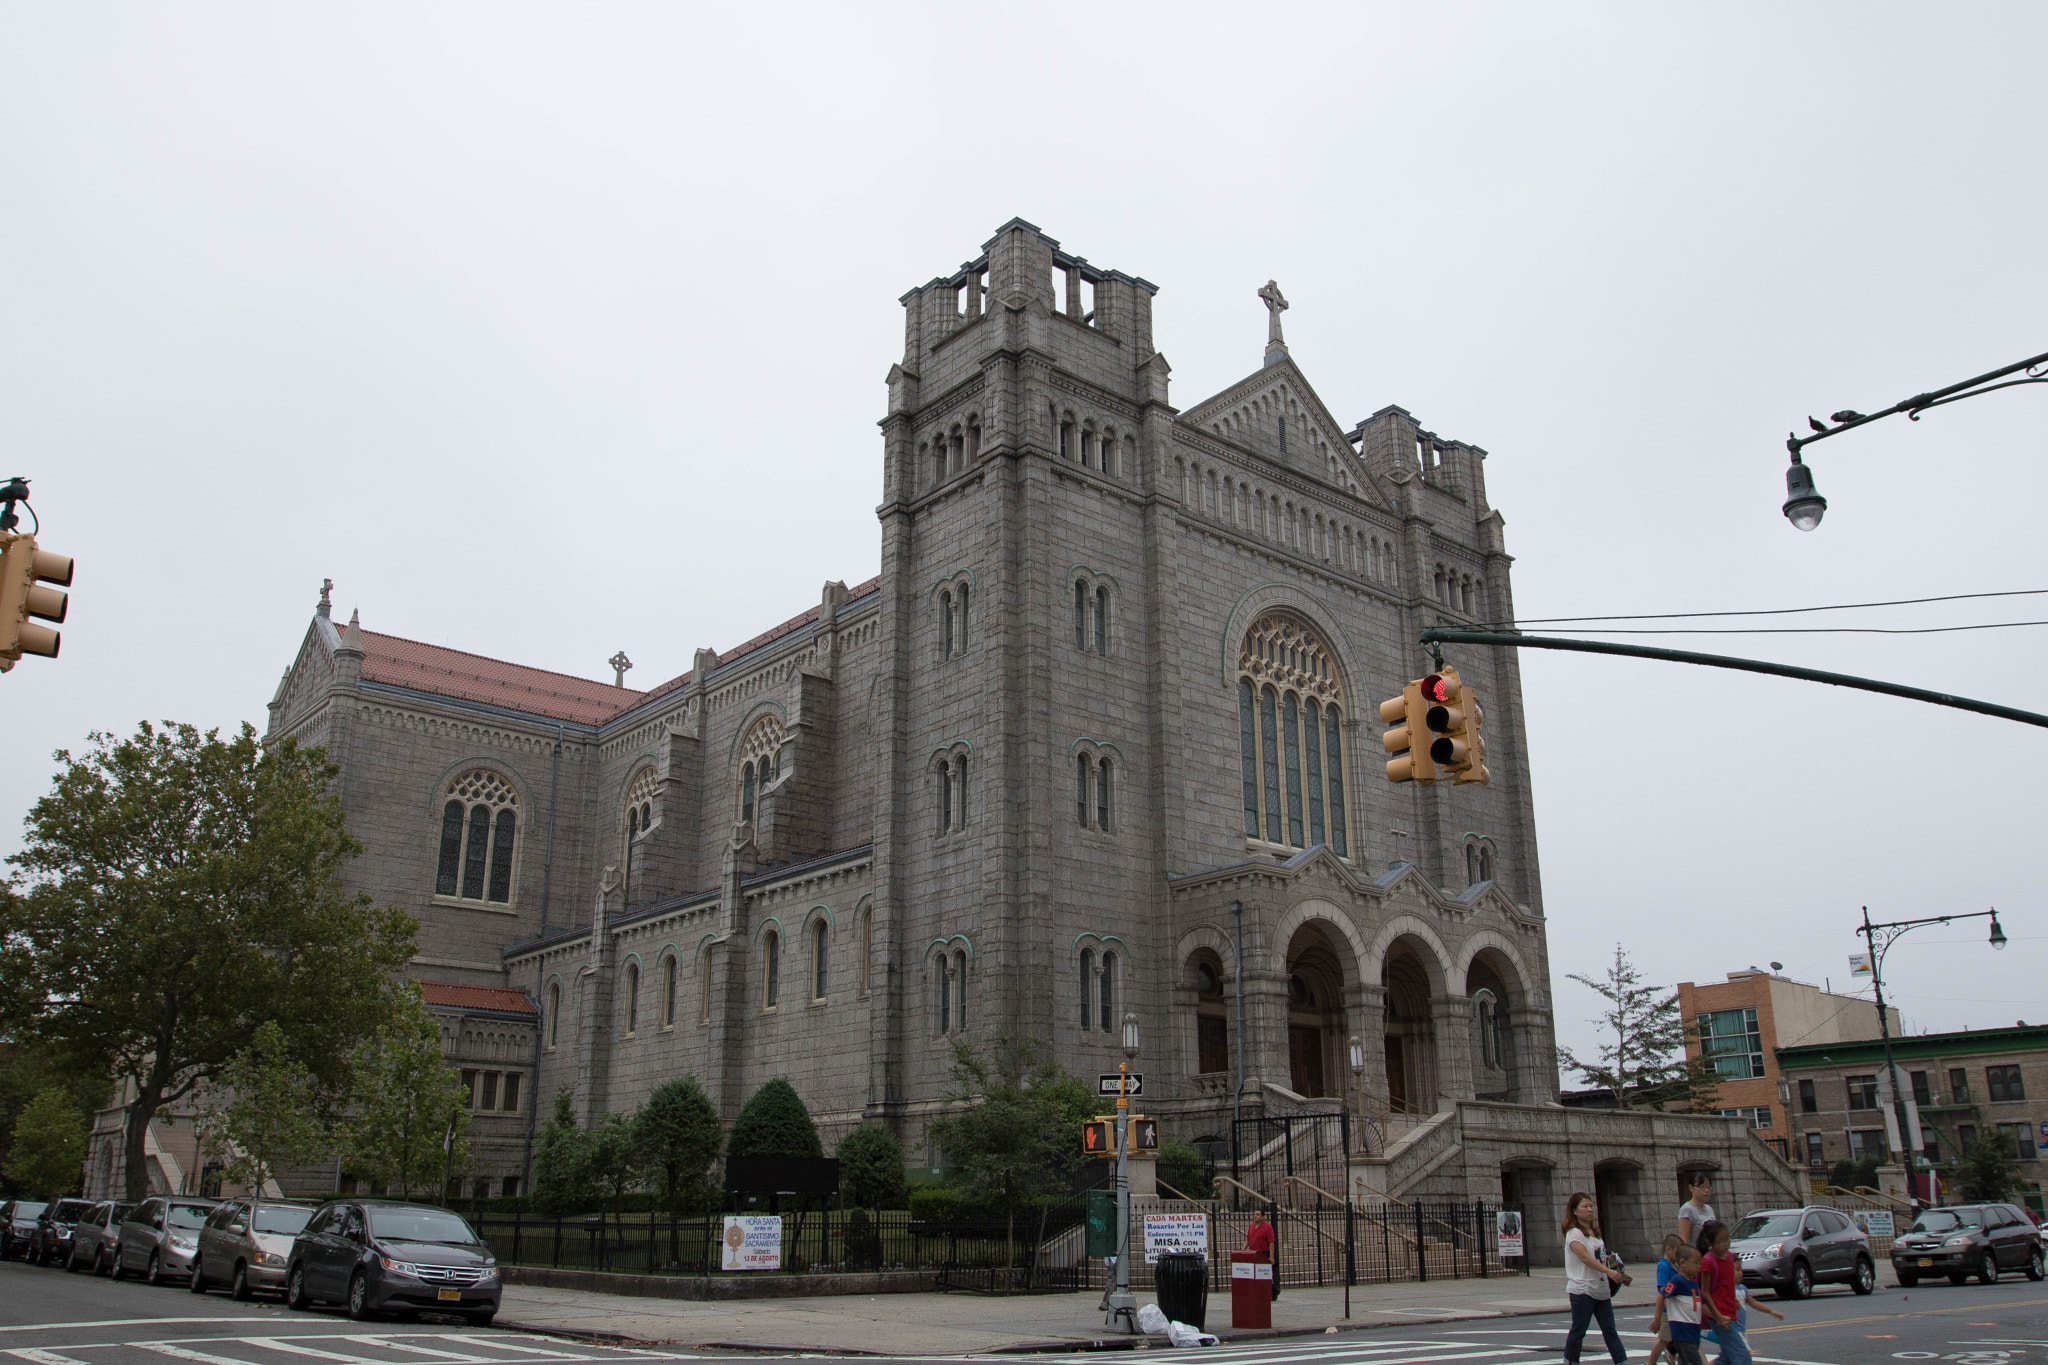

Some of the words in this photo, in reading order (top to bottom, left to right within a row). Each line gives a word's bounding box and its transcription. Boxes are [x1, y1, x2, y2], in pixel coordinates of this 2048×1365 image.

[1105, 1081, 1118, 1089] ONE
[746, 1217, 761, 1225] HORA
[762, 1217, 780, 1225] SANTA
[1154, 1238, 1181, 1246] MISA
[1664, 1281, 1675, 1294] 8
